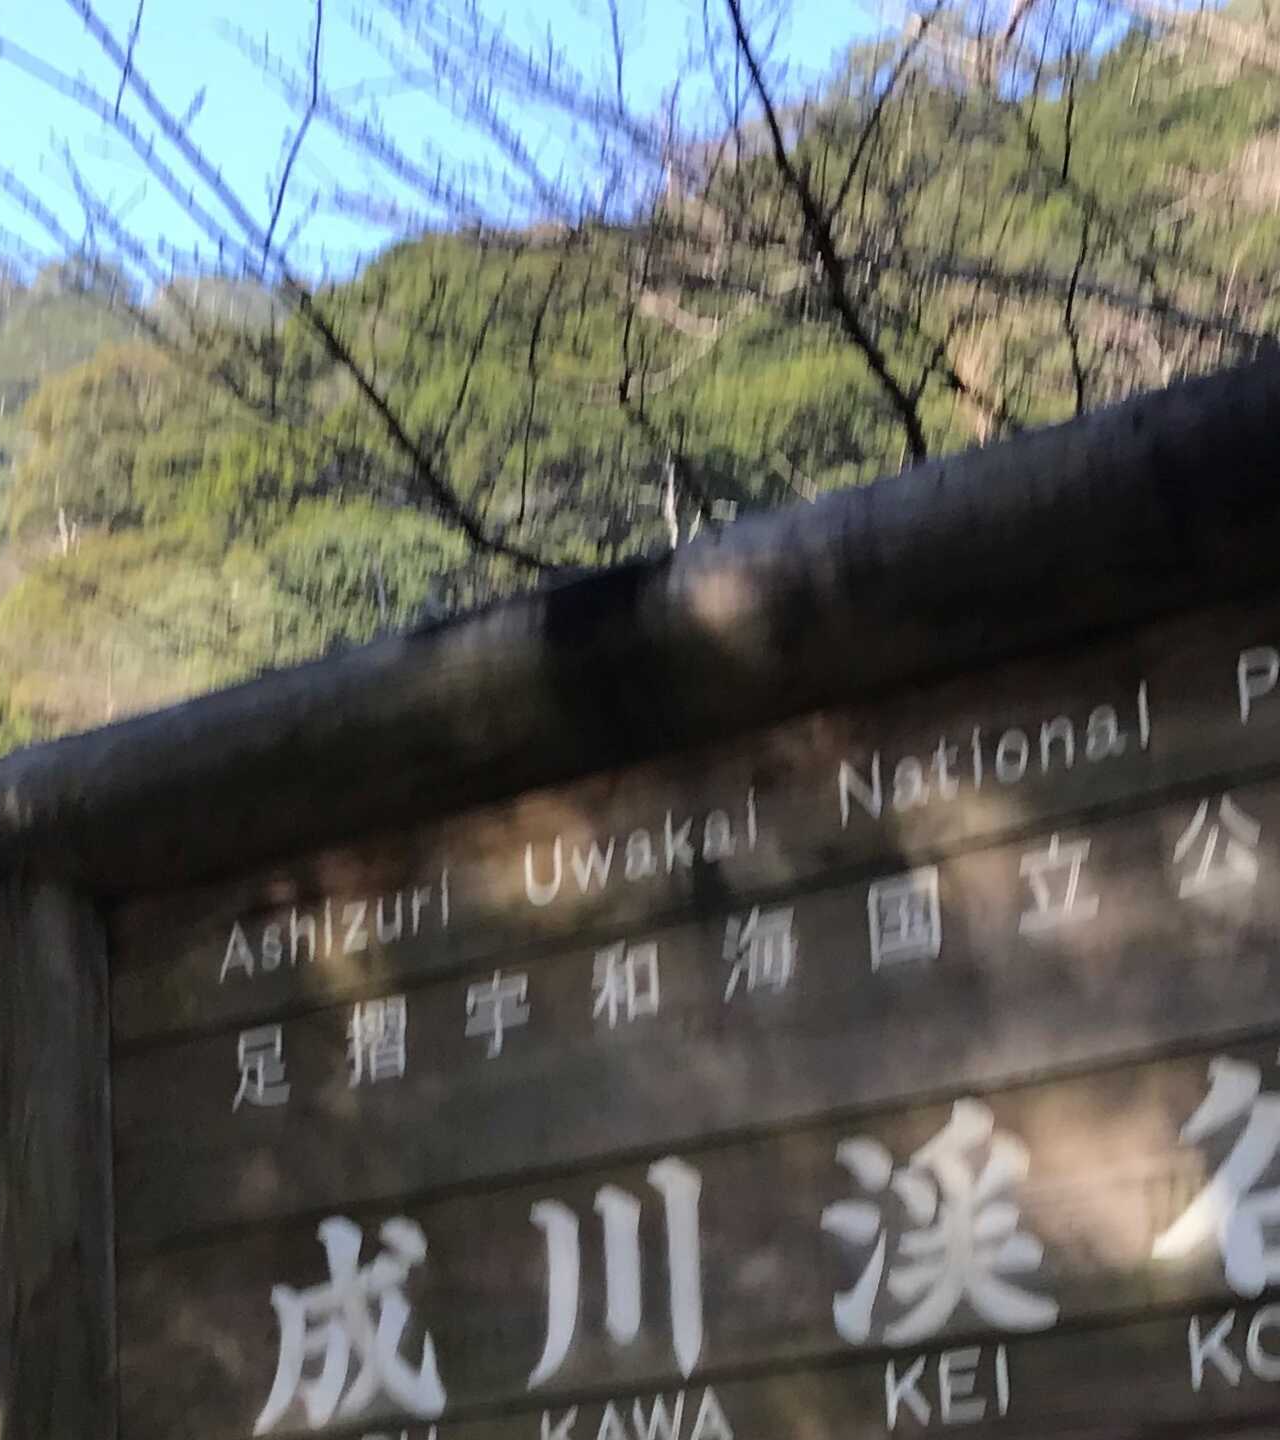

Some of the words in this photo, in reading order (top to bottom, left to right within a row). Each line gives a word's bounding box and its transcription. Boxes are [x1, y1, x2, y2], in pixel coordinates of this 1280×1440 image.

[219, 868, 451, 985] Ashizuri
[524, 786, 759, 906] Uwakai
[837, 679, 1150, 829] National
[884, 1343, 1010, 1431] KEI
